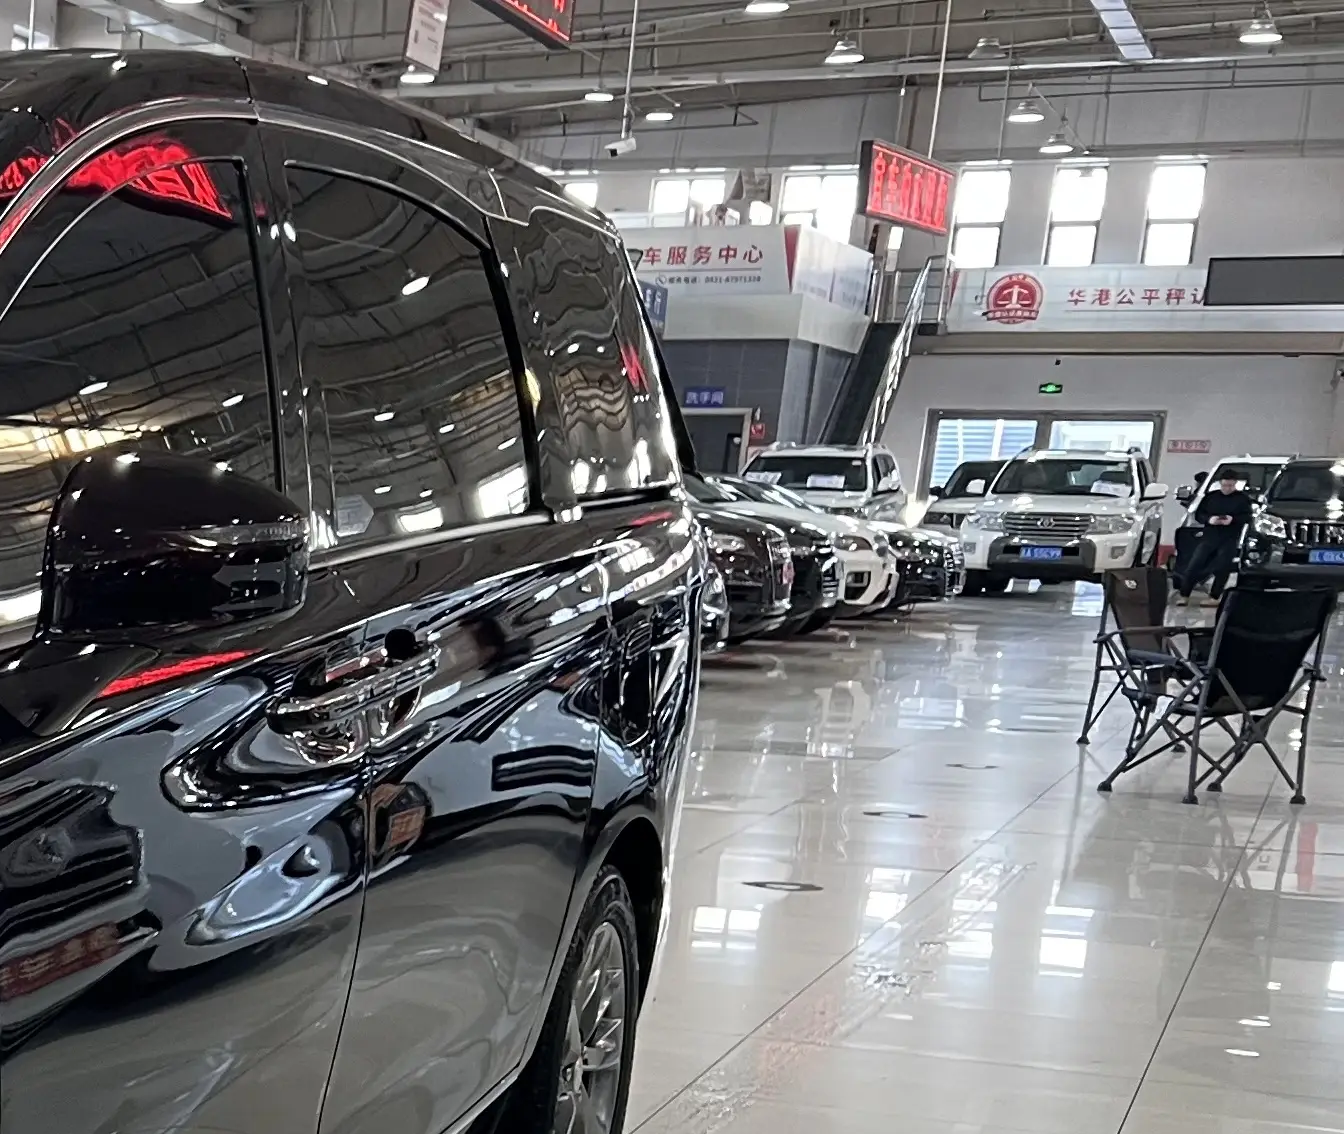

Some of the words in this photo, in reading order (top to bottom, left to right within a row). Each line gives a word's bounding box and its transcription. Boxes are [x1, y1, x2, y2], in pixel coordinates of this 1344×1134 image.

[643, 244, 764, 266] 车服务中心
